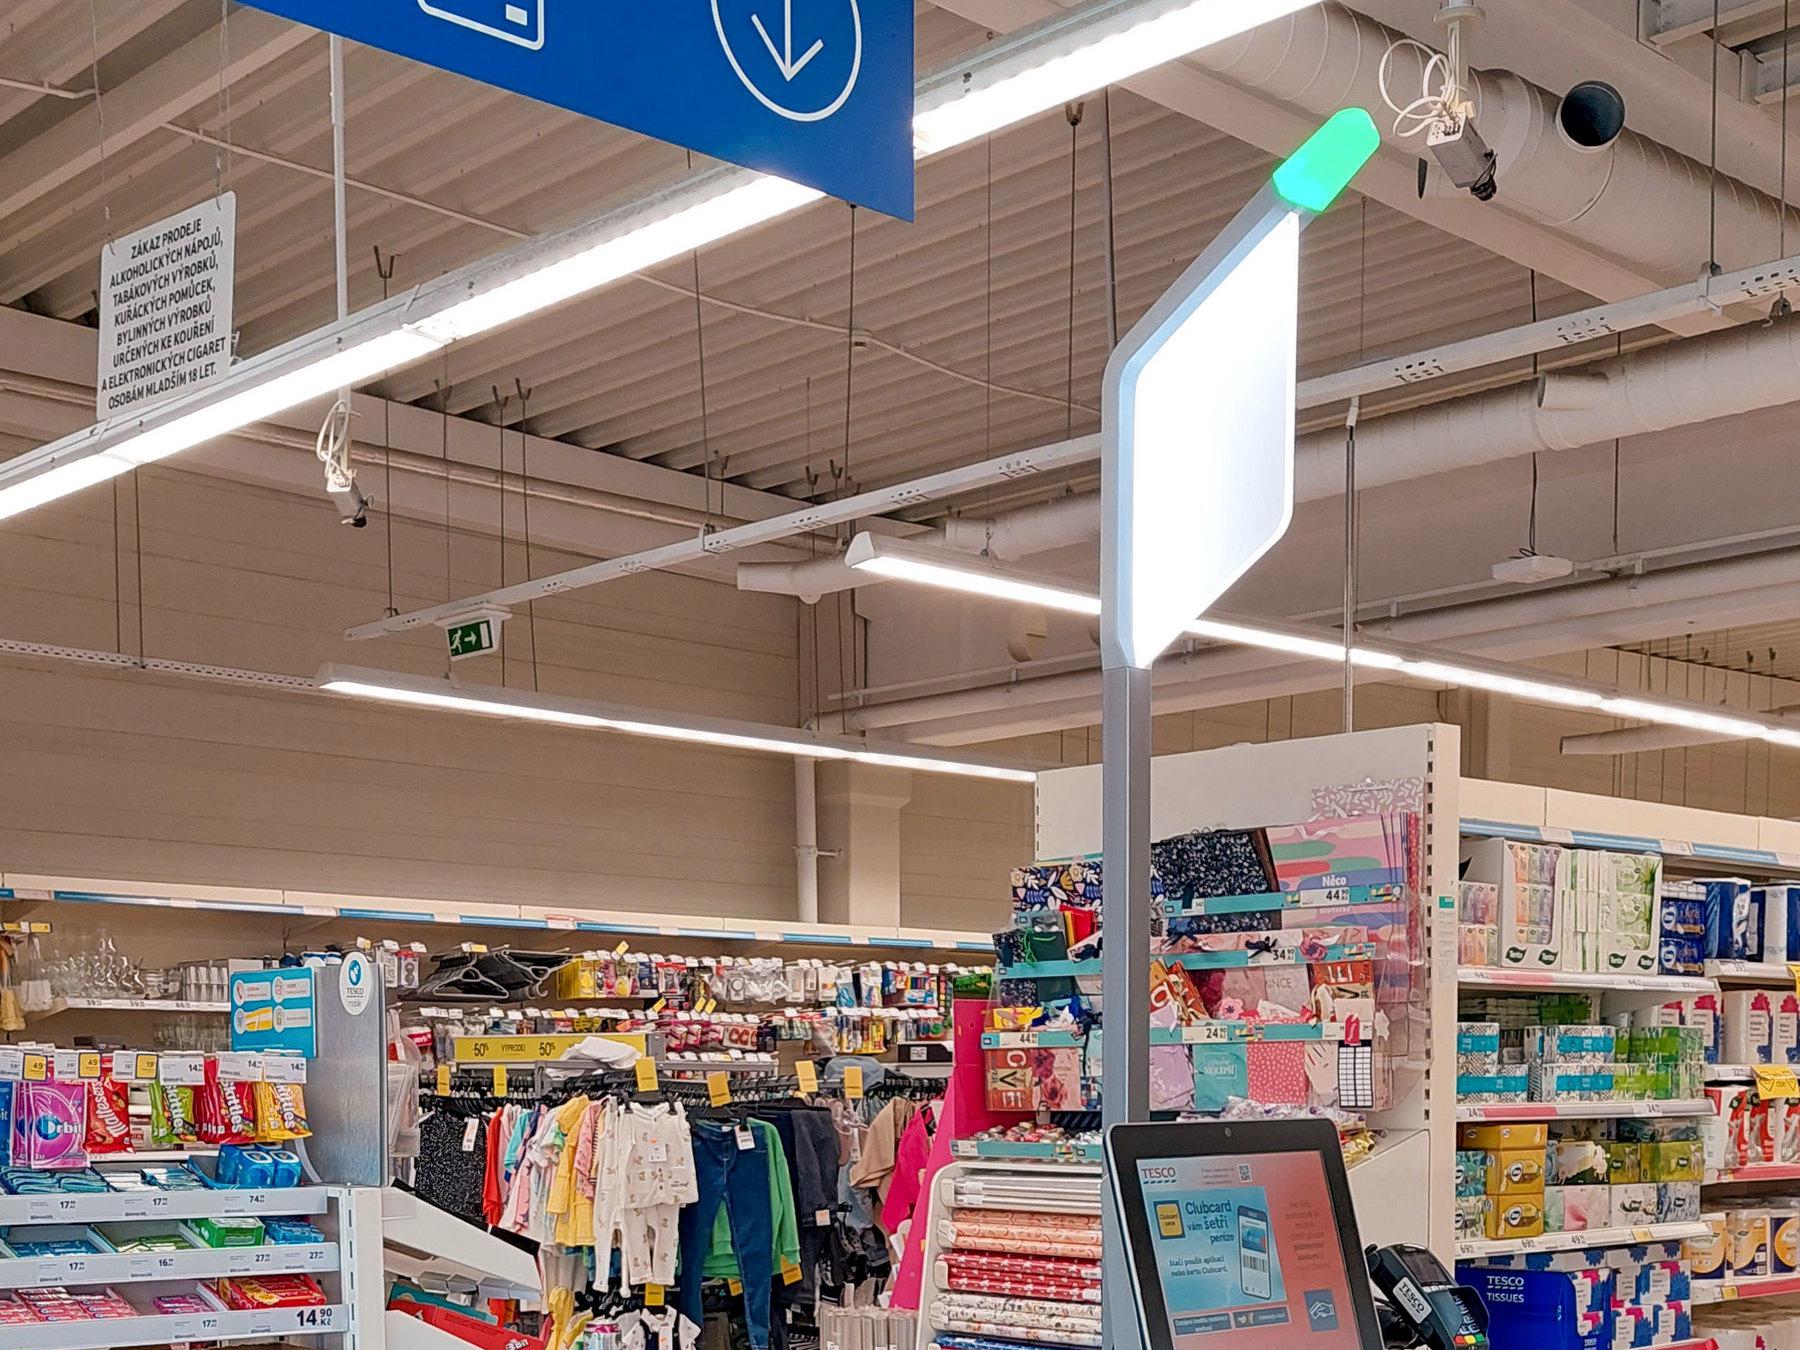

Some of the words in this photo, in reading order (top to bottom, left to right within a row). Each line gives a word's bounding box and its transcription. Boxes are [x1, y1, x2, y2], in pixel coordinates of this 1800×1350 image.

[131, 235, 160, 259] ZÁKAZ
[162, 218, 201, 247] PRODEJE
[109, 246, 182, 289] ALKOHOLICKÝCH
[185, 226, 223, 259] NÁPOJŮ,
[113, 272, 170, 307] TABÁKOVÝCH
[172, 249, 218, 284] VÝROBKŮ,
[114, 295, 167, 327] KUŘÁCKÝCH
[169, 277, 216, 306] POMŮCEK,
[117, 317, 166, 346] BYLINNÝCH
[167, 294, 212, 327] VÝROBKŮ
[113, 339, 160, 367] URČENÝCH
[160, 334, 172, 351] KE
[174, 314, 215, 346] KOUŘENÍ
[101, 378, 107, 392] A
[108, 350, 185, 389] ELEKTRONICKÝCH
[187, 336, 226, 362] CIGARET
[108, 384, 144, 410] OSOBÁM
[146, 370, 186, 397] MLADŠÍM
[188, 368, 198, 383] 18
[199, 361, 217, 380] LET.
[1326, 889, 1340, 901] 44
[1273, 950, 1285, 961] 34
[1206, 1028, 1219, 1038] 24
[1141, 1166, 1176, 1179] TESCO
[1185, 1200, 1232, 1215] Clubcard
[1486, 1275, 1524, 1286] TESCO
[1401, 1281, 1425, 1312] TESCO
[1486, 1292, 1524, 1303] TISSUES
[296, 1308, 317, 1327] 14
[320, 1308, 333, 1317] 90
